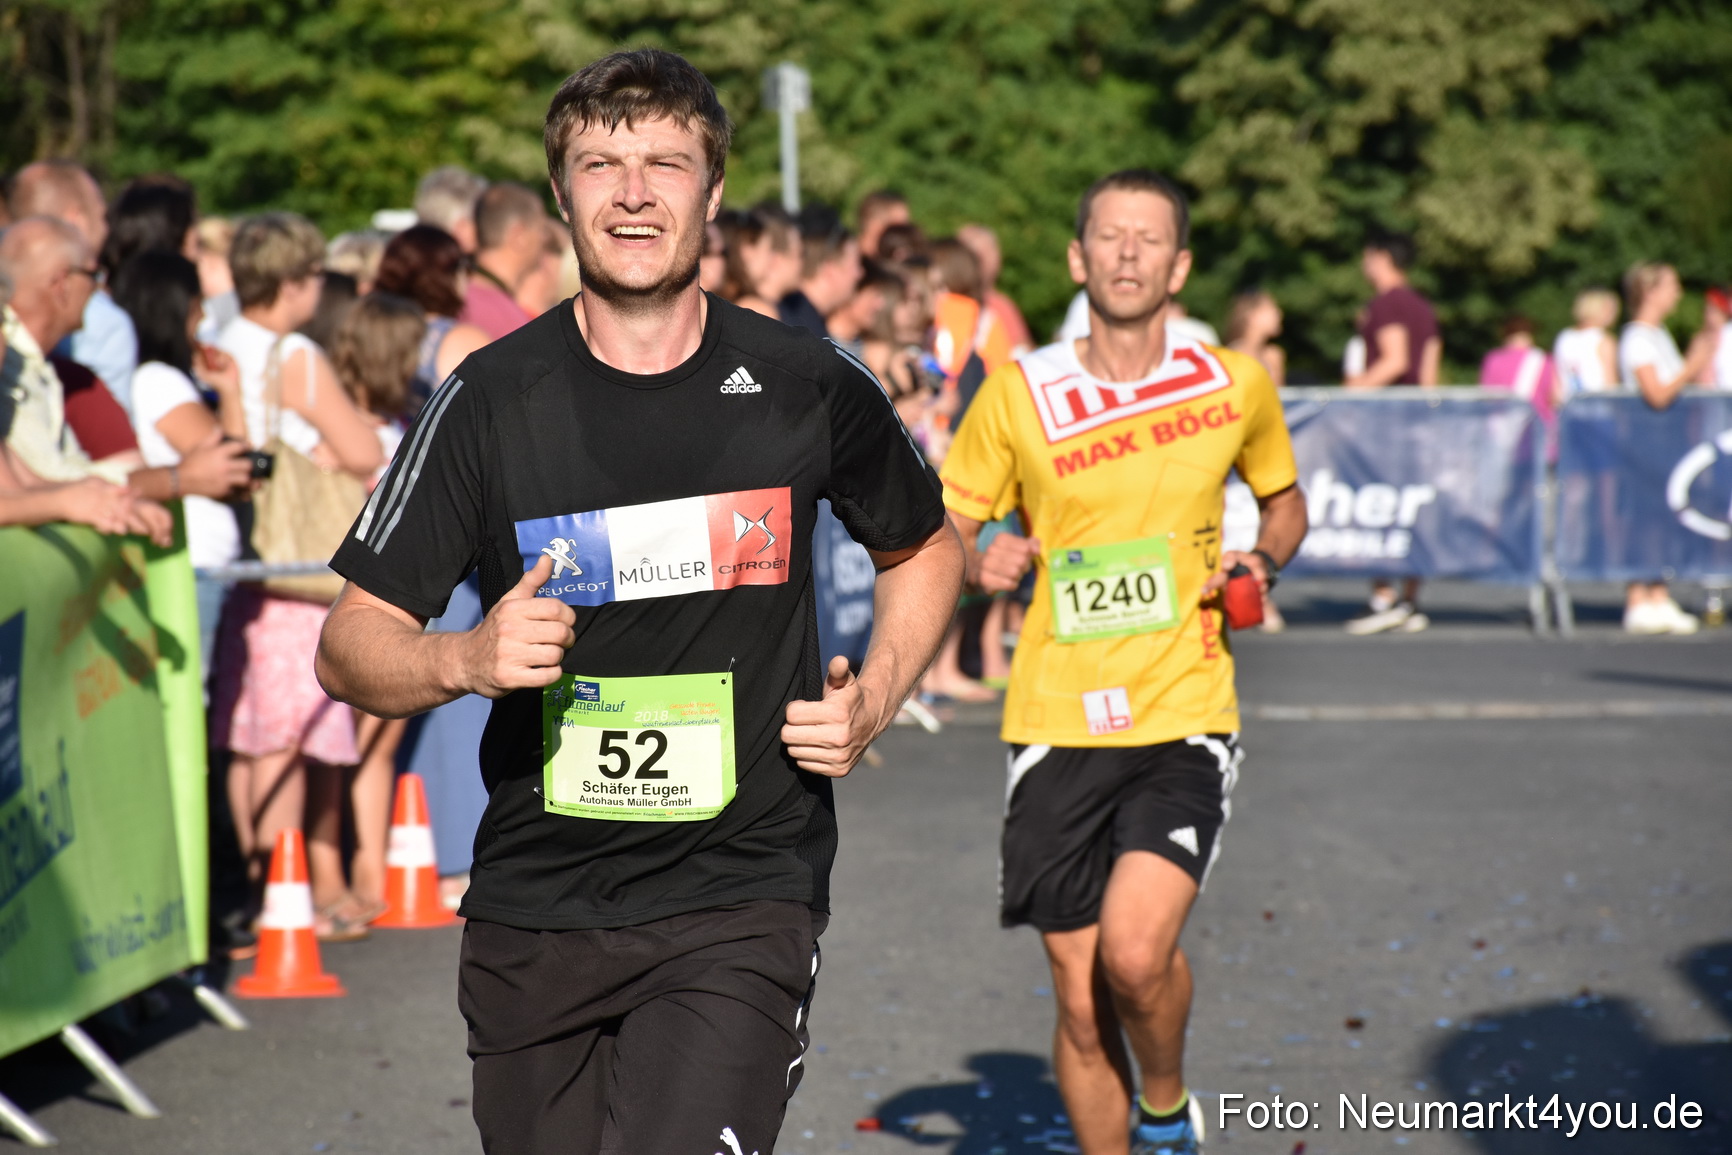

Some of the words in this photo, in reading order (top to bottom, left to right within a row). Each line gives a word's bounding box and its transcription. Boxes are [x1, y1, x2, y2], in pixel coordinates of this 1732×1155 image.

[720, 382, 762, 394] adidas
[1052, 431, 1141, 479] MAX
[1150, 401, 1242, 446] BÖGL
[538, 580, 609, 596] PEUGEOT
[1064, 573, 1157, 613] 1240
[634, 710, 669, 722] 2018
[597, 729, 669, 780] 52
[582, 780, 637, 795] Schäfer
[641, 783, 689, 798] Eugen
[579, 795, 624, 807] Autohaus
[627, 797, 658, 807] Müller
[660, 797, 692, 807] GmbH
